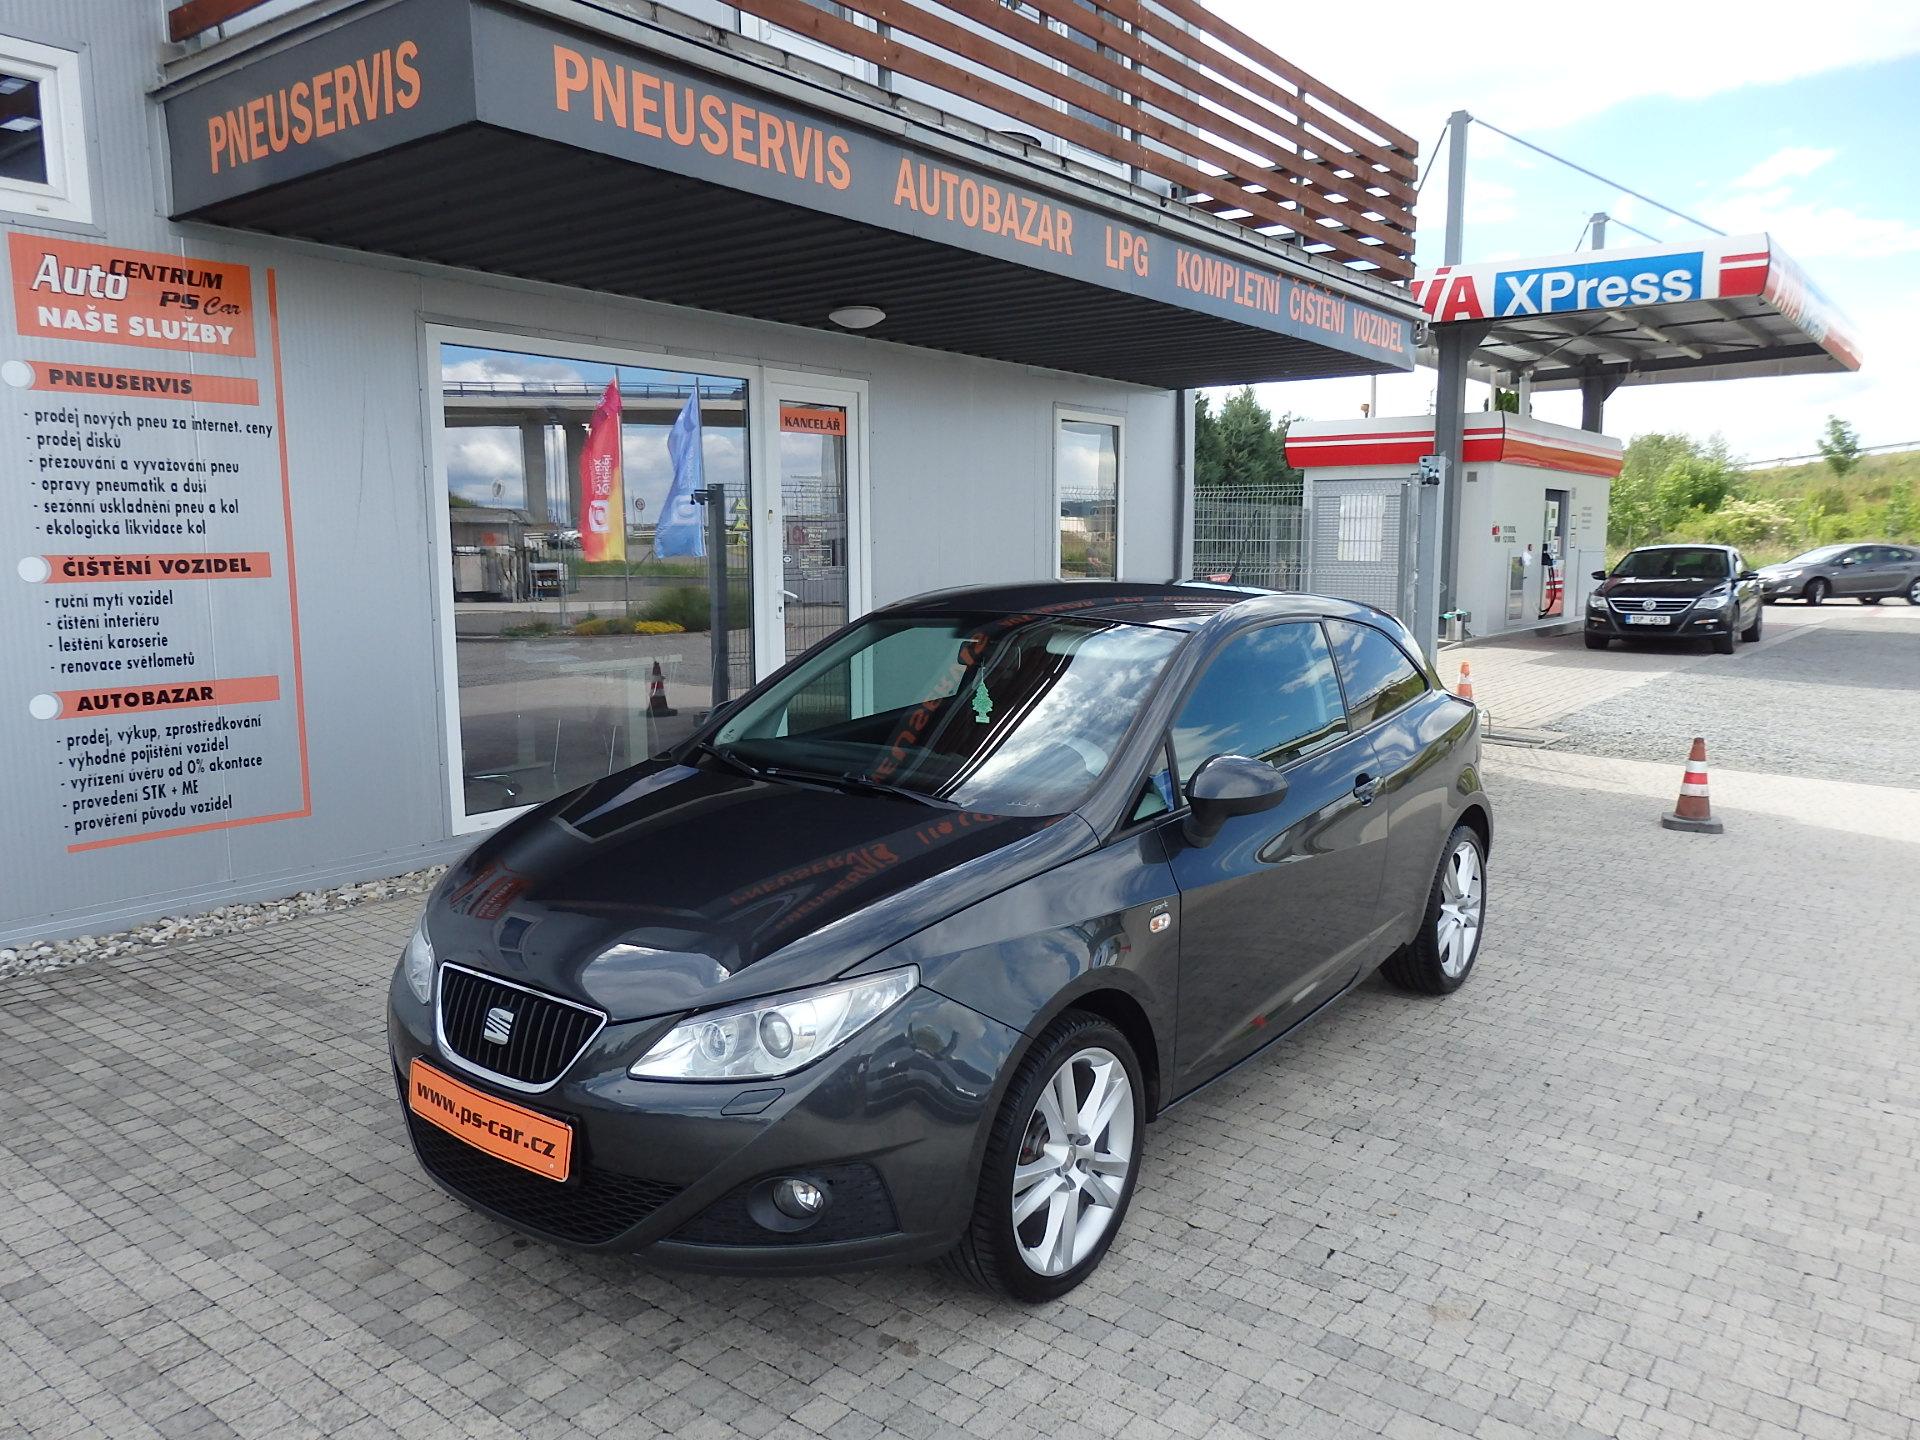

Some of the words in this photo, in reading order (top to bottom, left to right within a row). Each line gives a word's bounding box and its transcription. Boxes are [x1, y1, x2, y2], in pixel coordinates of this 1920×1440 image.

[208, 40, 422, 174] PNEUSERVIS
[553, 44, 852, 190] PNEUSERVIS
[893, 157, 1074, 256] AUTOBAZAR
[1105, 225, 1150, 277] LPG
[1176, 248, 1282, 316] KOMPLETNÍ
[1289, 277, 1348, 335] ČIŠTĚNÍ
[1352, 307, 1404, 353] VOZIDEL
[29, 253, 129, 300] Auto
[109, 259, 224, 290] CENTRUM
[159, 291, 200, 310] PS
[203, 296, 242, 316] Car
[1502, 268, 1693, 317] XPress
[37, 304, 119, 333] NAŠE
[128, 316, 234, 345] SLUŽBY
[49, 368, 193, 395] PNEUSERVIS
[35, 408, 80, 428] prodej
[84, 411, 132, 430] nových
[137, 416, 167, 431] pneu
[172, 418, 187, 430] za
[246, 422, 273, 438] ceny
[784, 415, 841, 431] KANCELÁŘ
[37, 432, 82, 452] prodej
[121, 459, 128, 471] a
[211, 462, 240, 477] pneu
[42, 479, 90, 496] opravy
[96, 477, 166, 495] pneumatik
[171, 481, 178, 493] a
[175, 502, 205, 516] pneu
[209, 503, 216, 515] a
[221, 499, 239, 515] kol
[46, 518, 121, 539] ekologická
[125, 519, 183, 536] likvidace
[188, 519, 206, 535] kol
[63, 556, 151, 577] ČIŠTĚNÍ
[158, 558, 251, 575] VOZIDEL
[55, 592, 88, 609] ruční
[128, 589, 174, 606] vozidel
[104, 612, 160, 629] interiéru
[108, 632, 168, 650] karoserie
[61, 658, 122, 674] renovace
[127, 651, 195, 670] světlometů
[77, 686, 215, 712] AUTOBAZAR
[69, 750, 126, 771] výhodné
[187, 736, 229, 754] vozidel
[168, 762, 183, 777] od
[209, 754, 263, 773] akontace
[73, 790, 138, 814] provedení
[142, 784, 166, 801] STK
[182, 780, 199, 795] ME
[142, 803, 186, 825] původu
[191, 795, 232, 814] vozidel
[416, 1082, 556, 1159] www.ps-car.cz
